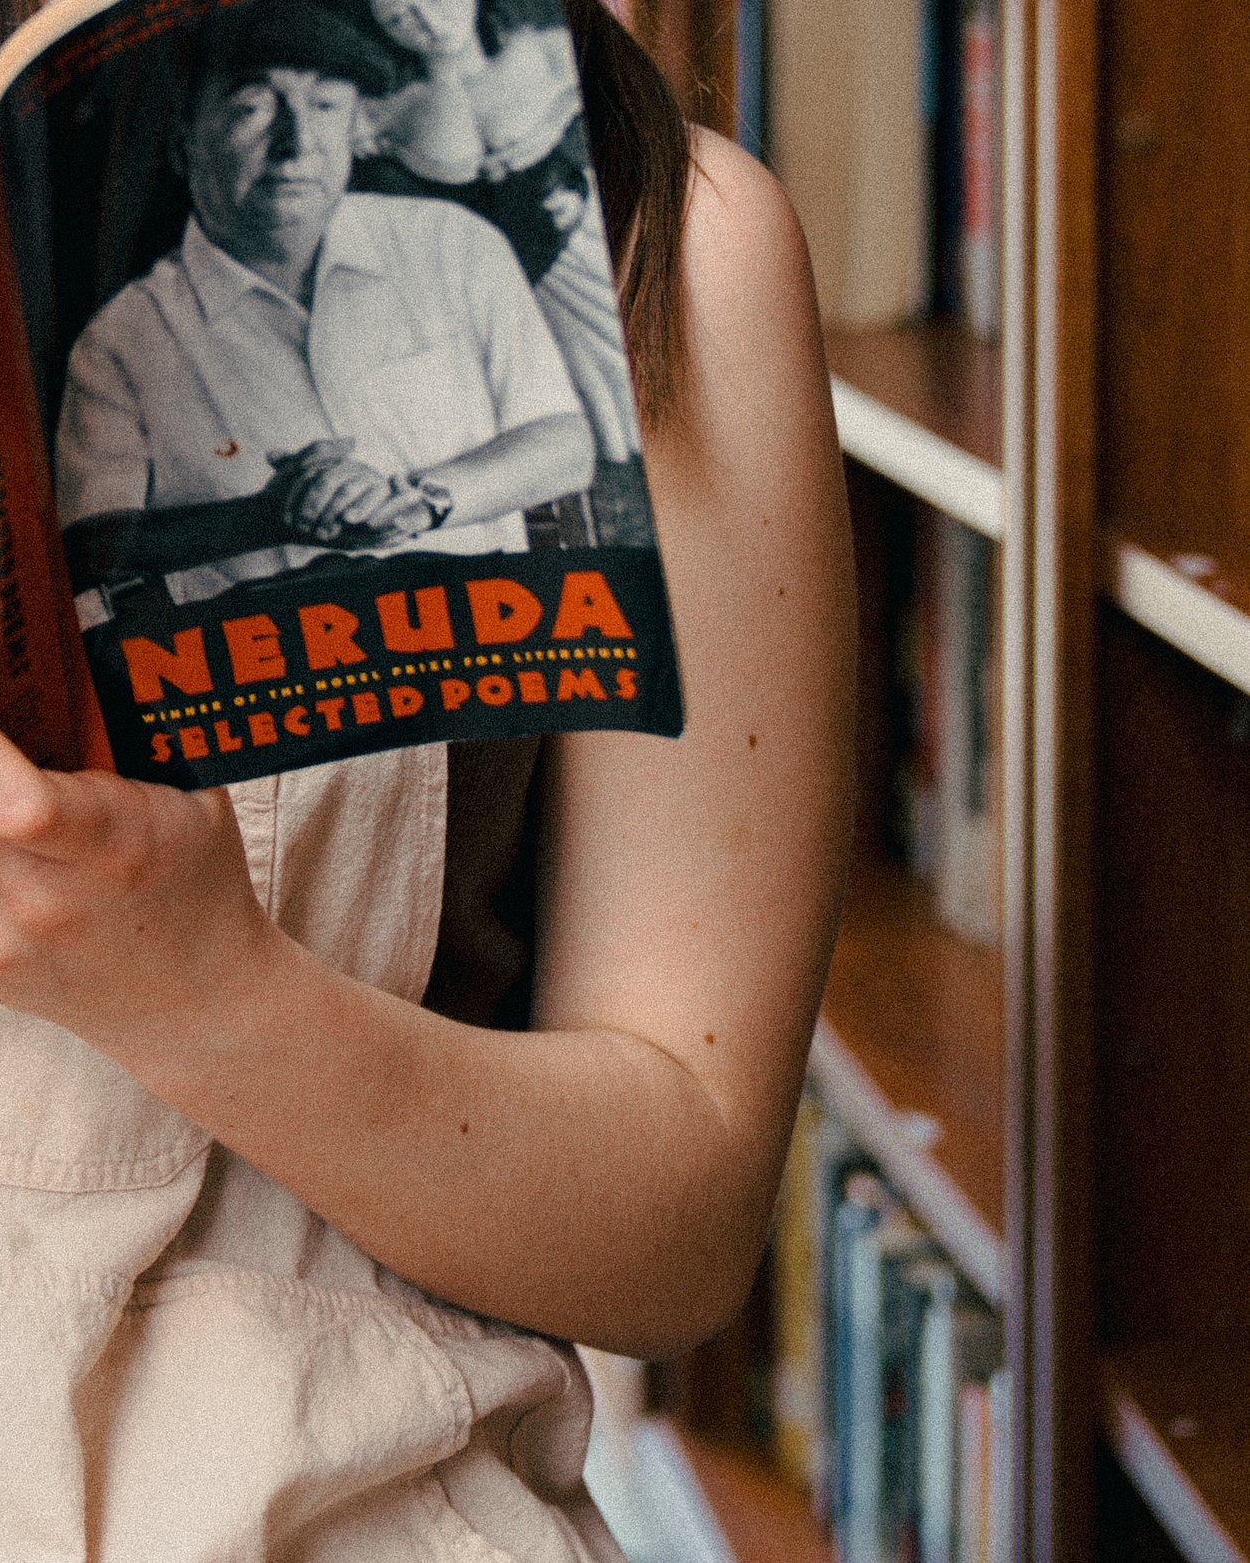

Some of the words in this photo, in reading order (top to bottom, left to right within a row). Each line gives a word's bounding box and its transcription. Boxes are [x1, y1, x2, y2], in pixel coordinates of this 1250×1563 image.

[121, 571, 633, 703] NERUDA
[141, 699, 222, 723] WINNER
[234, 690, 258, 708] OF
[269, 682, 305, 701] THE
[315, 670, 381, 692] NOBEL
[391, 657, 453, 678] PRIZE
[463, 652, 502, 669] FOR
[512, 645, 638, 664] LITERATURE
[150, 684, 425, 764] SELECTED
[440, 667, 640, 712] POEMS
